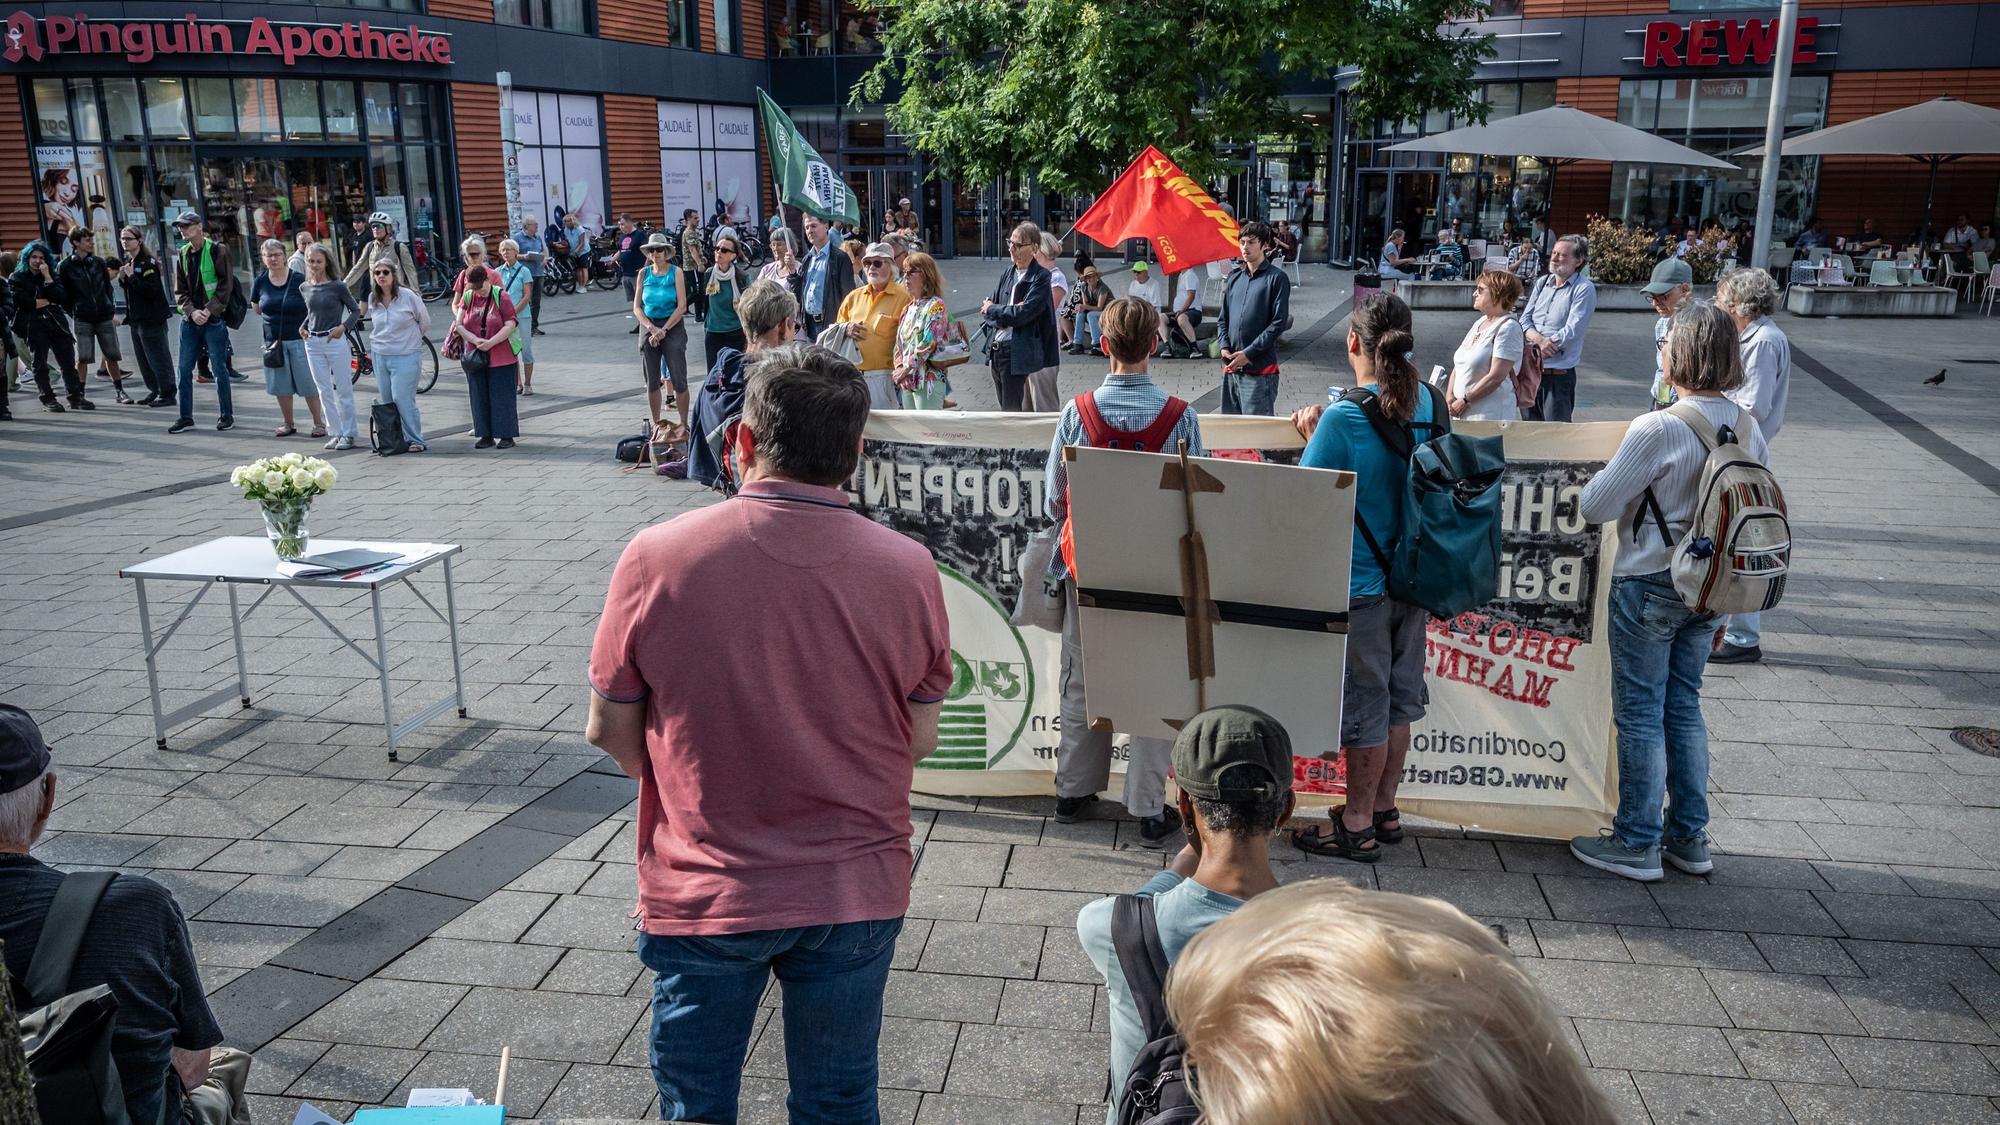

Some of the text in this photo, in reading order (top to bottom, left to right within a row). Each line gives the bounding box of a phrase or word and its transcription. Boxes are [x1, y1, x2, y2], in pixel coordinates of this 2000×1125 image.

[46, 13, 450, 64] Pinguin Apotheke
[1643, 17, 1819, 67] REWE
[1043, 580, 1062, 598] Ta
